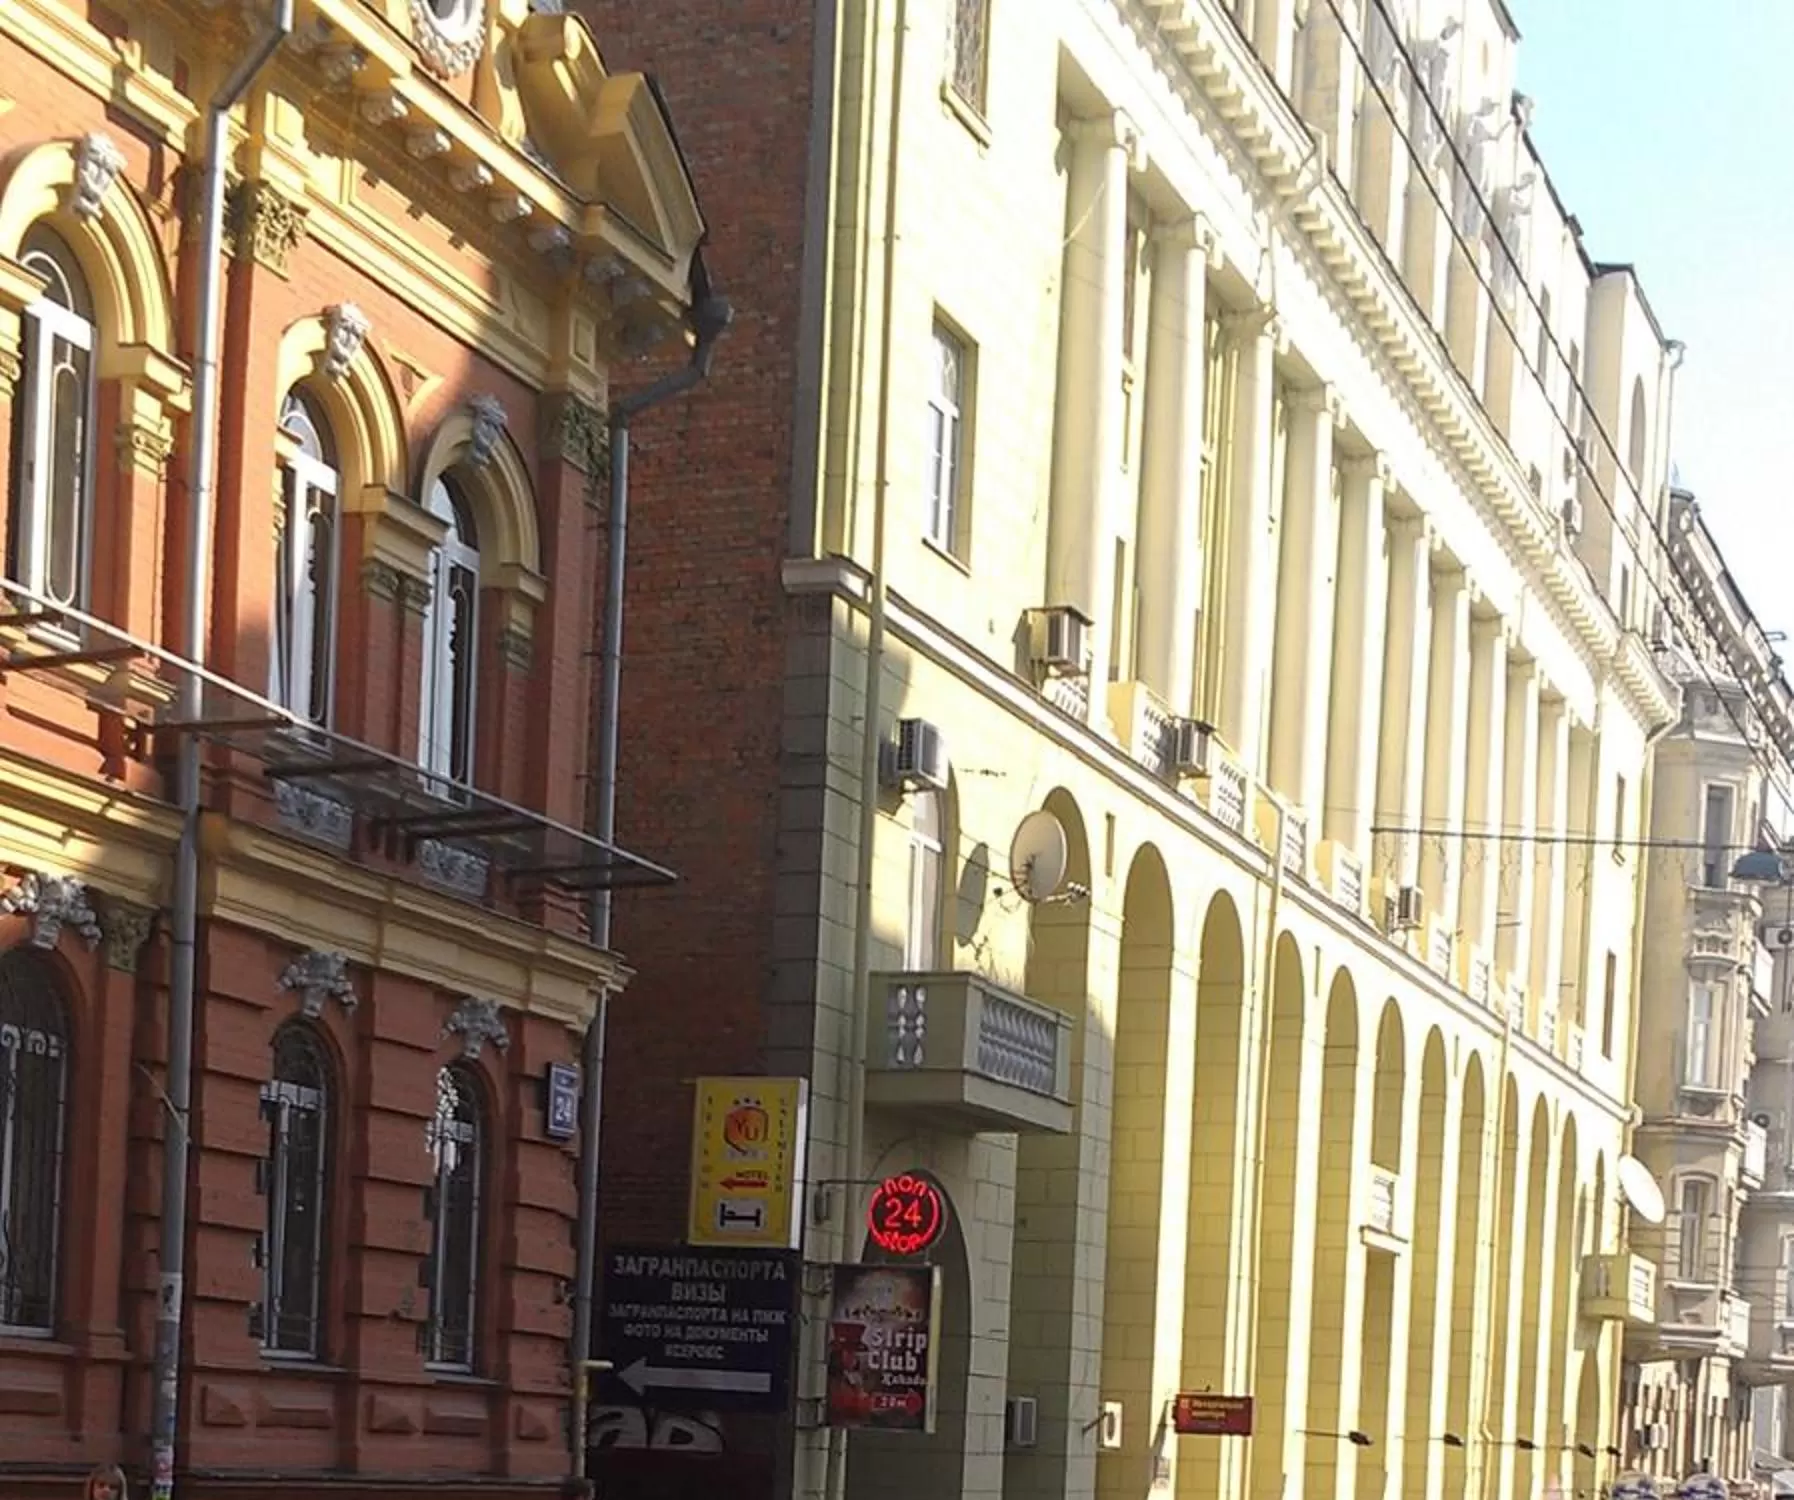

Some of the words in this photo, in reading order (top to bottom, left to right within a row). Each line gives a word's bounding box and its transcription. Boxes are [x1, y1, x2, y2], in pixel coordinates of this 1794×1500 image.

[885, 1198, 922, 1228] 24
[613, 1254, 786, 1281] ЗАГРАНПАСПОРТА
[671, 1282, 726, 1303] ВИЗЫ
[623, 1322, 662, 1338] ФОТО
[685, 1325, 769, 1343] ДОКУМЕНТЫ
[867, 1350, 918, 1372] Club
